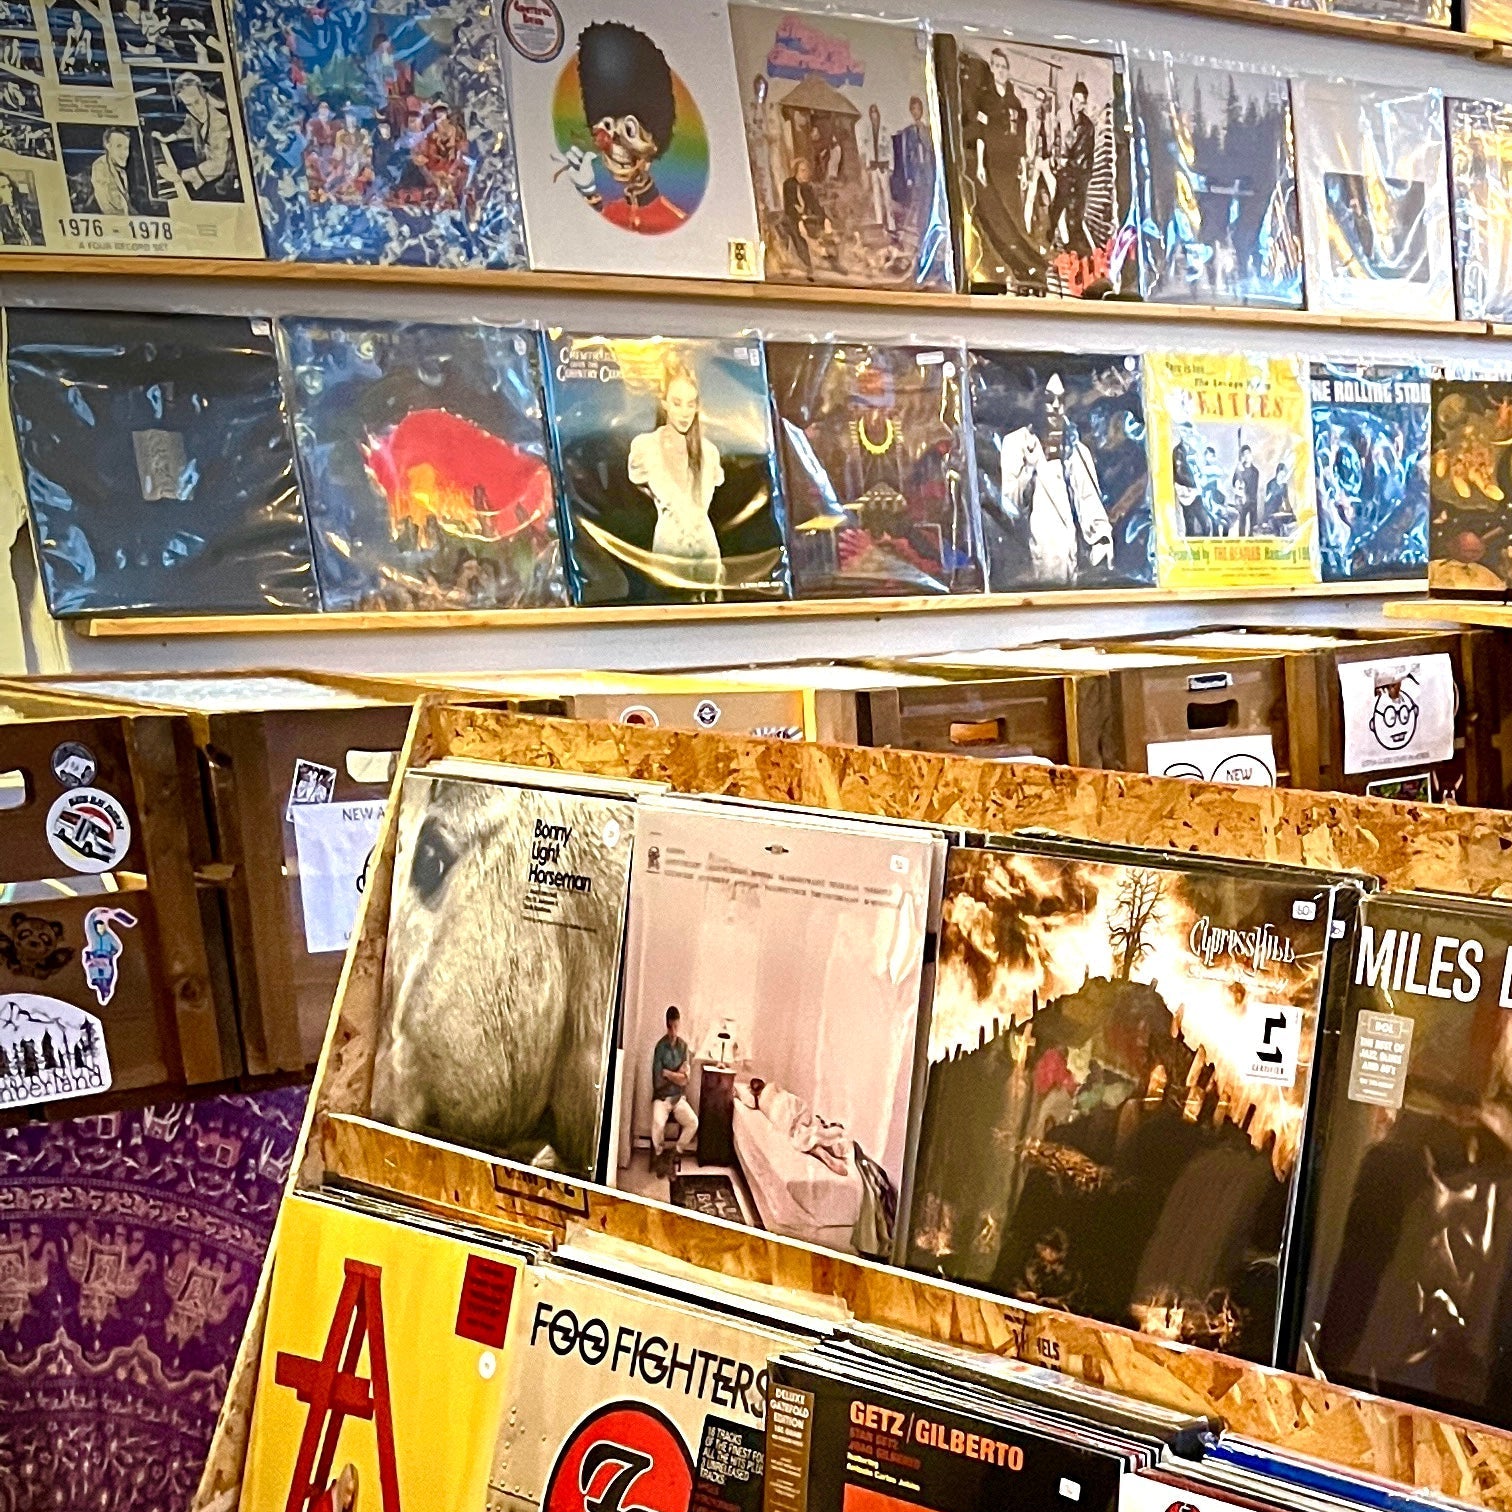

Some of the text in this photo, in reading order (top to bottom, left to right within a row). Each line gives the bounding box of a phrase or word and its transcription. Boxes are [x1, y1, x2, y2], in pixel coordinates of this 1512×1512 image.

[58, 218, 104, 237] 1976
[128, 220, 173, 241] 1978
[1334, 382, 1391, 402] ROLLING
[1394, 382, 1430, 403] STON
[1226, 768, 1253, 782] NEW
[342, 807, 374, 821] NEW
[534, 818, 573, 848] Bonny
[528, 862, 592, 892] Horseman
[1355, 925, 1484, 1003] MILES
[531, 1302, 770, 1424] FOO FIGHTERS
[717, 1427, 742, 1446] TRACKS
[728, 1442, 753, 1458] FINEST
